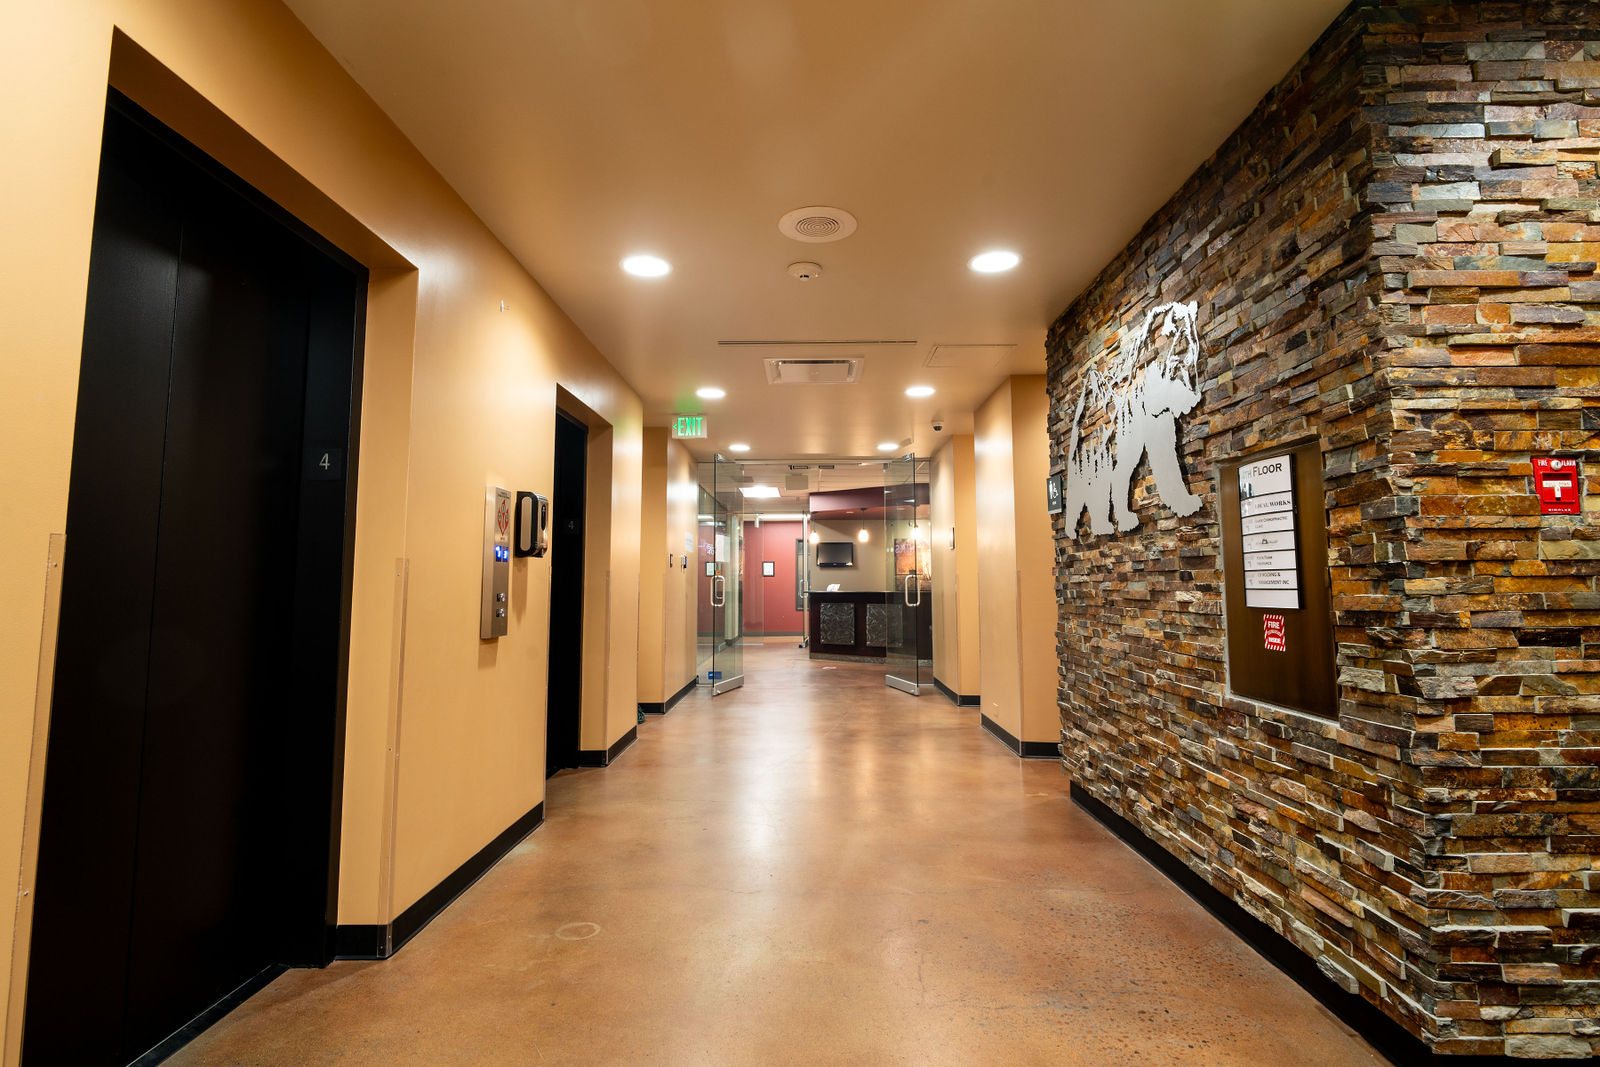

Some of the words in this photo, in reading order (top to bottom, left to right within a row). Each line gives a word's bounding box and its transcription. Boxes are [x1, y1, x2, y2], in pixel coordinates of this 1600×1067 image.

[677, 416, 704, 437] EXIT
[319, 452, 330, 470] 4
[1252, 463, 1282, 477] FLOOR
[1267, 621, 1280, 629] FIRE
